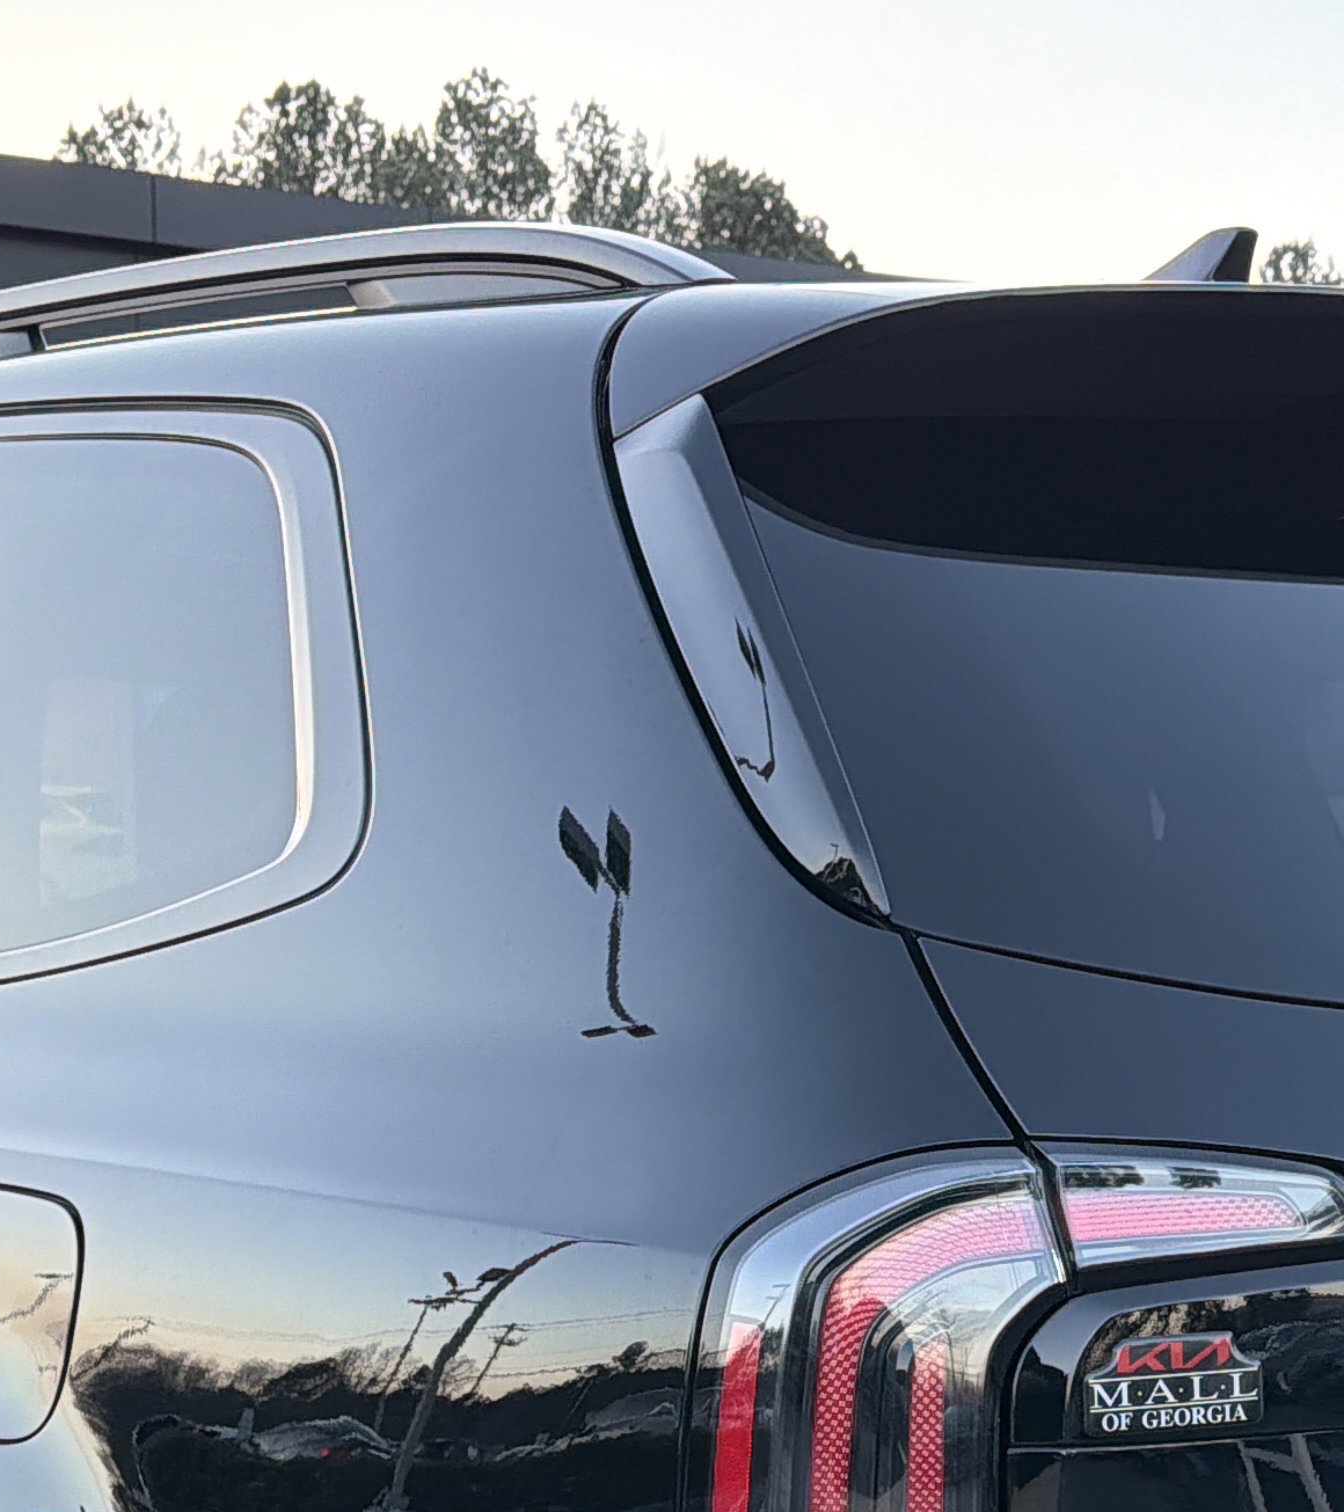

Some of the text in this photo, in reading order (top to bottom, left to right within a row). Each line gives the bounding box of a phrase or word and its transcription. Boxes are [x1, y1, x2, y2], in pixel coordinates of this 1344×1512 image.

[1116, 1338, 1231, 1374] KIA
[1101, 1403, 1249, 1432] OF GEORGIA
